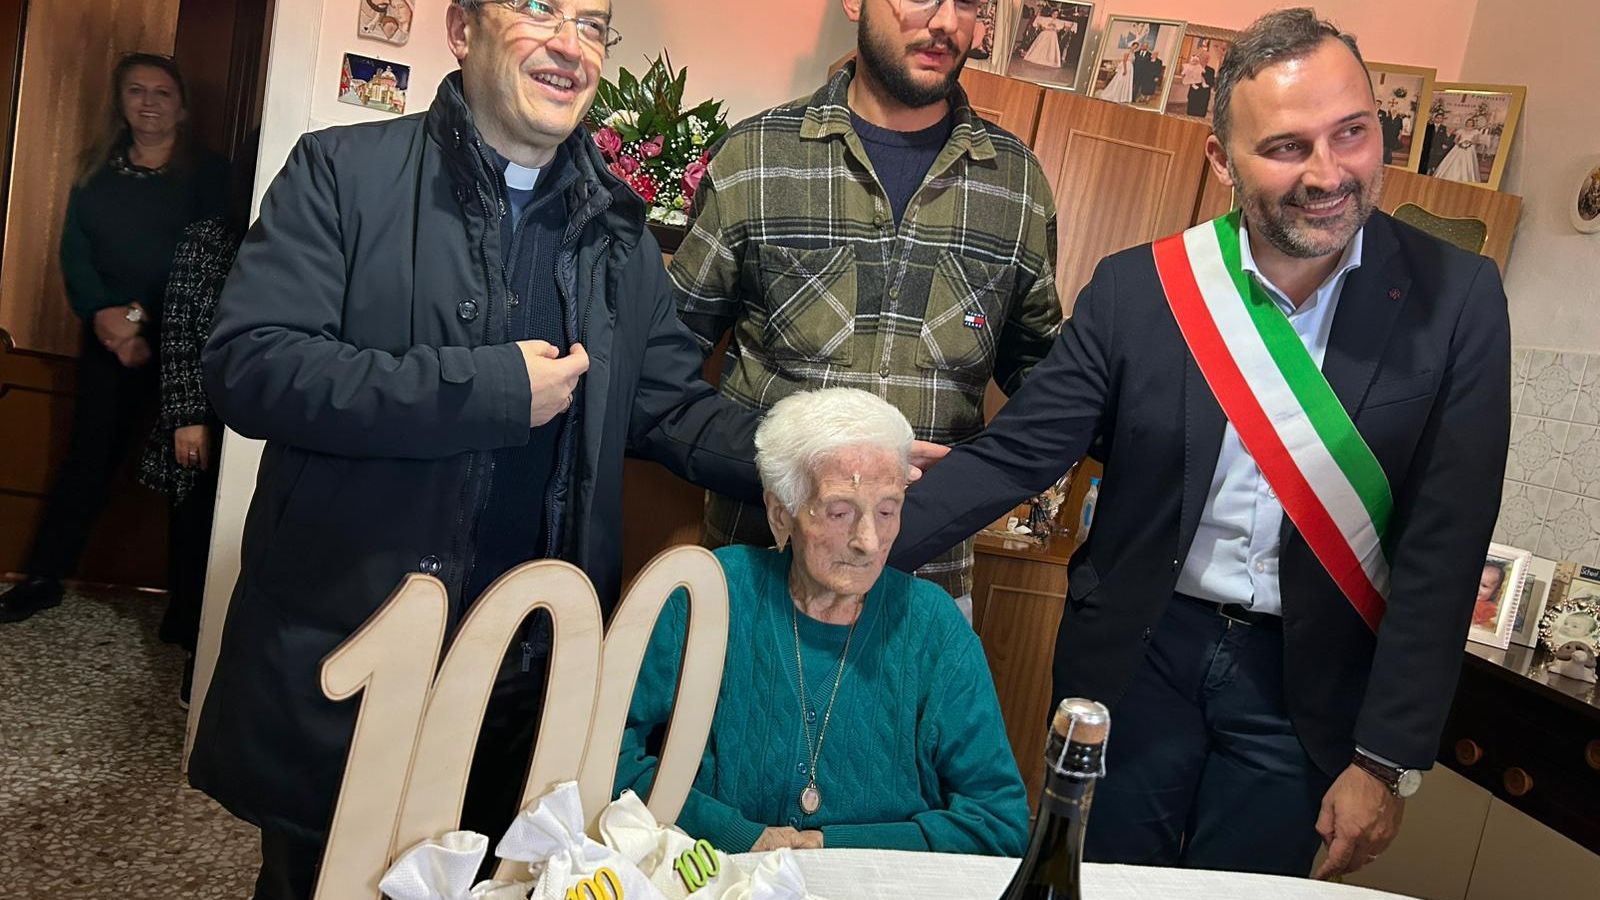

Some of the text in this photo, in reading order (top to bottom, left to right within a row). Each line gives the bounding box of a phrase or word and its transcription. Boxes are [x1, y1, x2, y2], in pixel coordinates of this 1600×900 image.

[312, 545, 729, 900] 100
[564, 866, 625, 900] 00
[673, 838, 720, 893] 100
